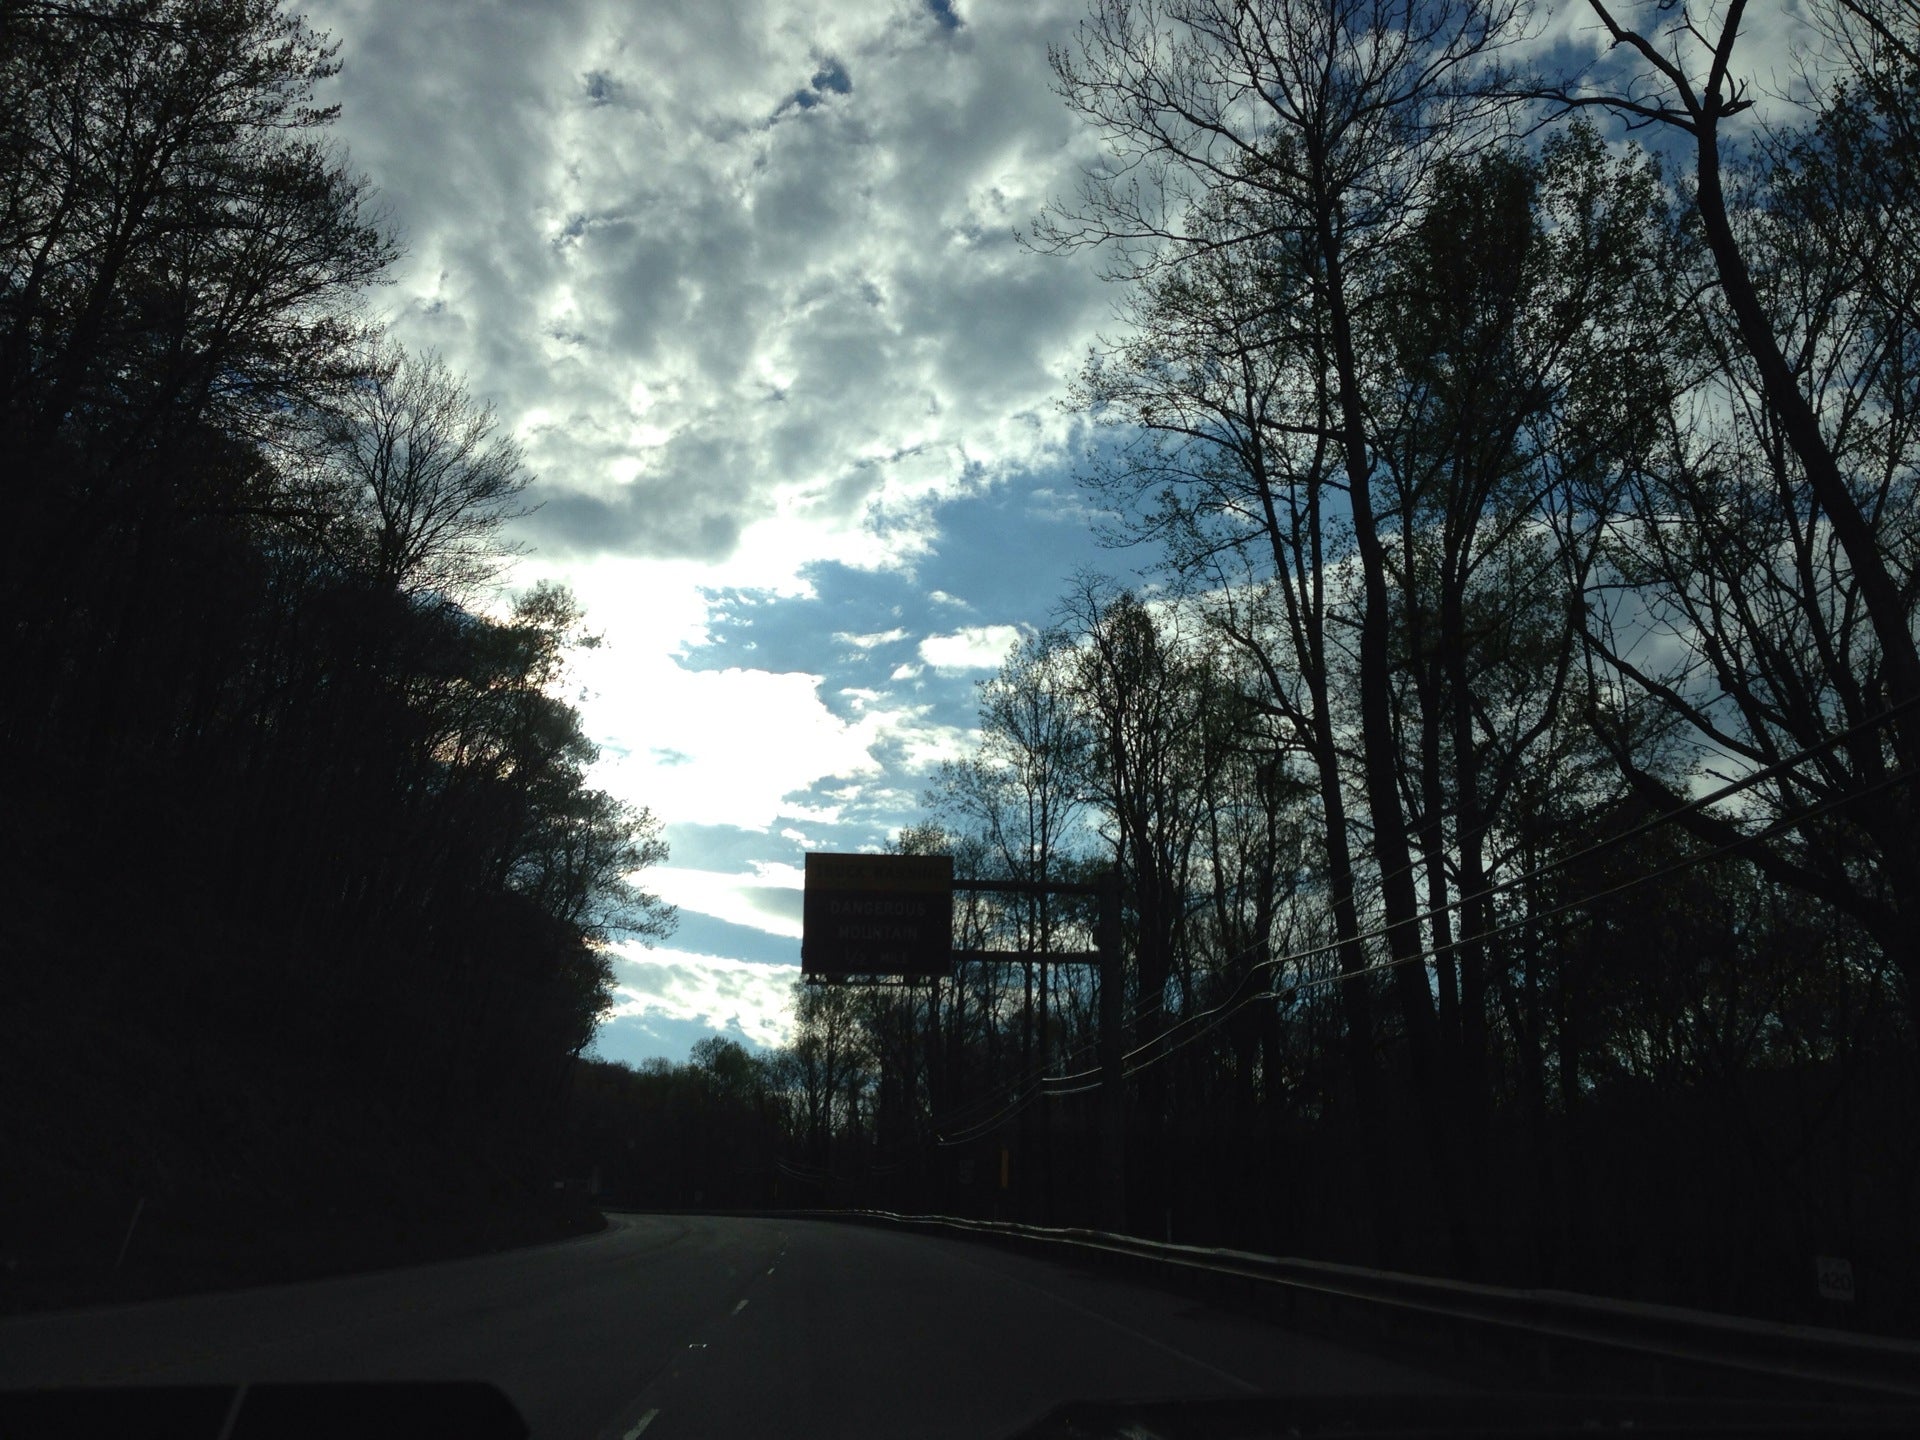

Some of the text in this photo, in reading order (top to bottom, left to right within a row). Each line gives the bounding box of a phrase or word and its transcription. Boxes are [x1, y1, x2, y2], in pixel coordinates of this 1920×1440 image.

[830, 900, 926, 916] DANGEROUS
[838, 925, 918, 940] MOUNTAIN
[880, 951, 908, 964] MILE
